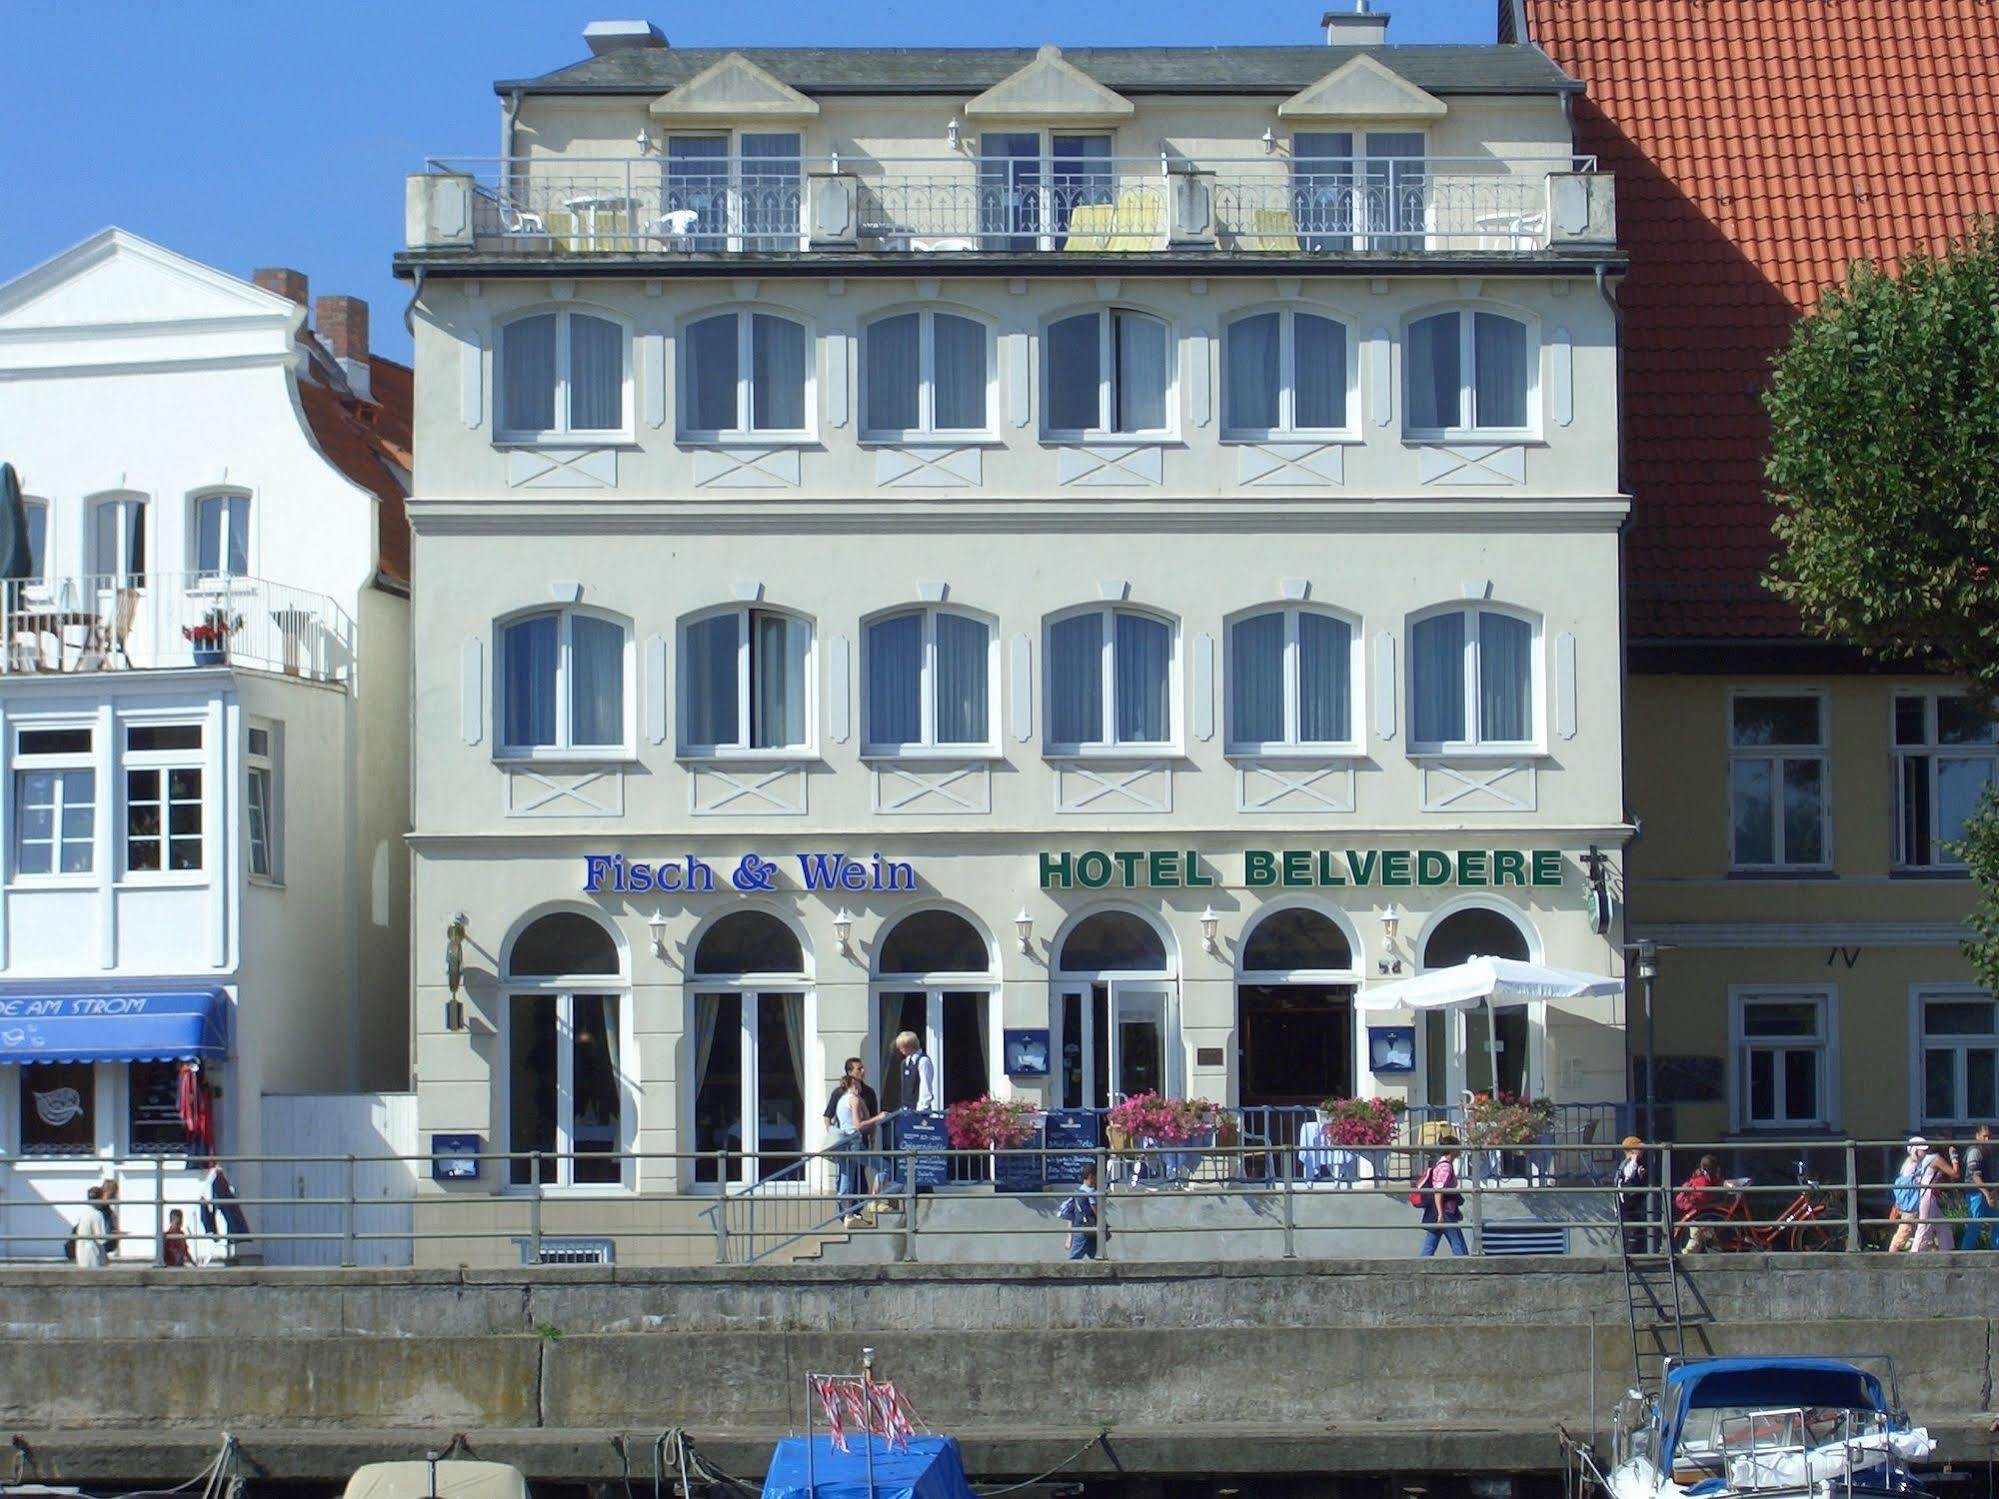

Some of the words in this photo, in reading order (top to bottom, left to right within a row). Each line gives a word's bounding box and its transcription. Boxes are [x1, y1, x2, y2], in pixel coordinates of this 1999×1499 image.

[583, 853, 715, 893] Fisch
[732, 853, 778, 891] &
[796, 852, 917, 891] Wein
[1039, 850, 1213, 889] HOTEL
[1243, 850, 1563, 887] BELVEDERE
[25, 999, 64, 1016] AM
[71, 998, 147, 1015] STROM
